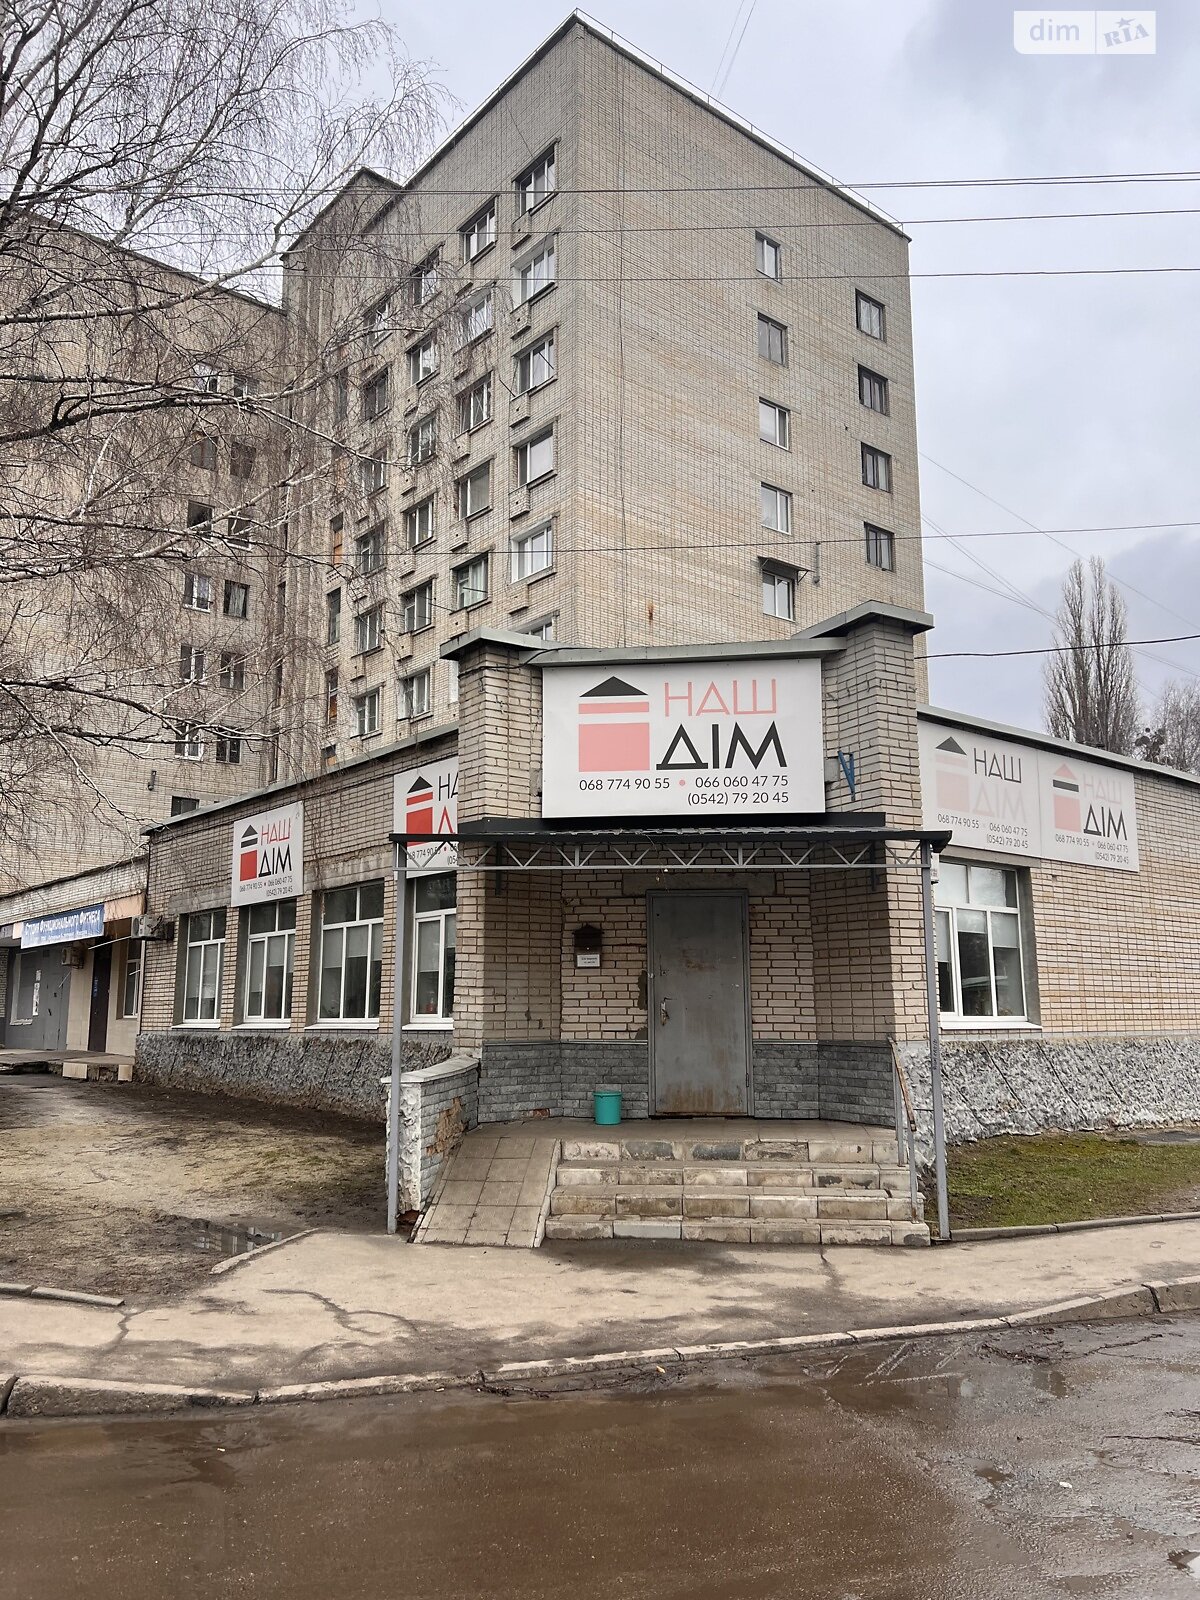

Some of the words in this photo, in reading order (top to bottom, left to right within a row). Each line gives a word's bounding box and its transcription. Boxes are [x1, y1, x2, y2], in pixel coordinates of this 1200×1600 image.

[665, 679, 776, 717] НАШ
[656, 721, 787, 770] ДІМ
[974, 748, 1021, 783] НАШ
[579, 779, 603, 790] 068
[608, 779, 630, 790] 774
[635, 778, 650, 789] 90
[655, 777, 669, 789] 55
[695, 776, 719, 788] 066
[723, 776, 748, 787] 060
[752, 775, 767, 787] 47
[772, 775, 788, 787] 75
[688, 793, 728, 805] (0542)
[733, 792, 748, 804] 79
[753, 792, 768, 803] 20
[772, 792, 788, 803] 45
[1083, 773, 1122, 805] НАШ
[971, 783, 1026, 823] ДІМ
[261, 818, 290, 846] НАШ
[938, 814, 949, 823] 068
[951, 816, 962, 826] 774
[964, 818, 970, 827] 90
[972, 820, 979, 828] 55
[990, 823, 1000, 832] 066
[1002, 825, 1012, 834] 060
[1021, 828, 1027, 836] 75
[1084, 804, 1127, 840] ДІМ
[987, 834, 1004, 846] (0542)
[1014, 839, 1020, 847] 20
[259, 844, 292, 877] ДІМ
